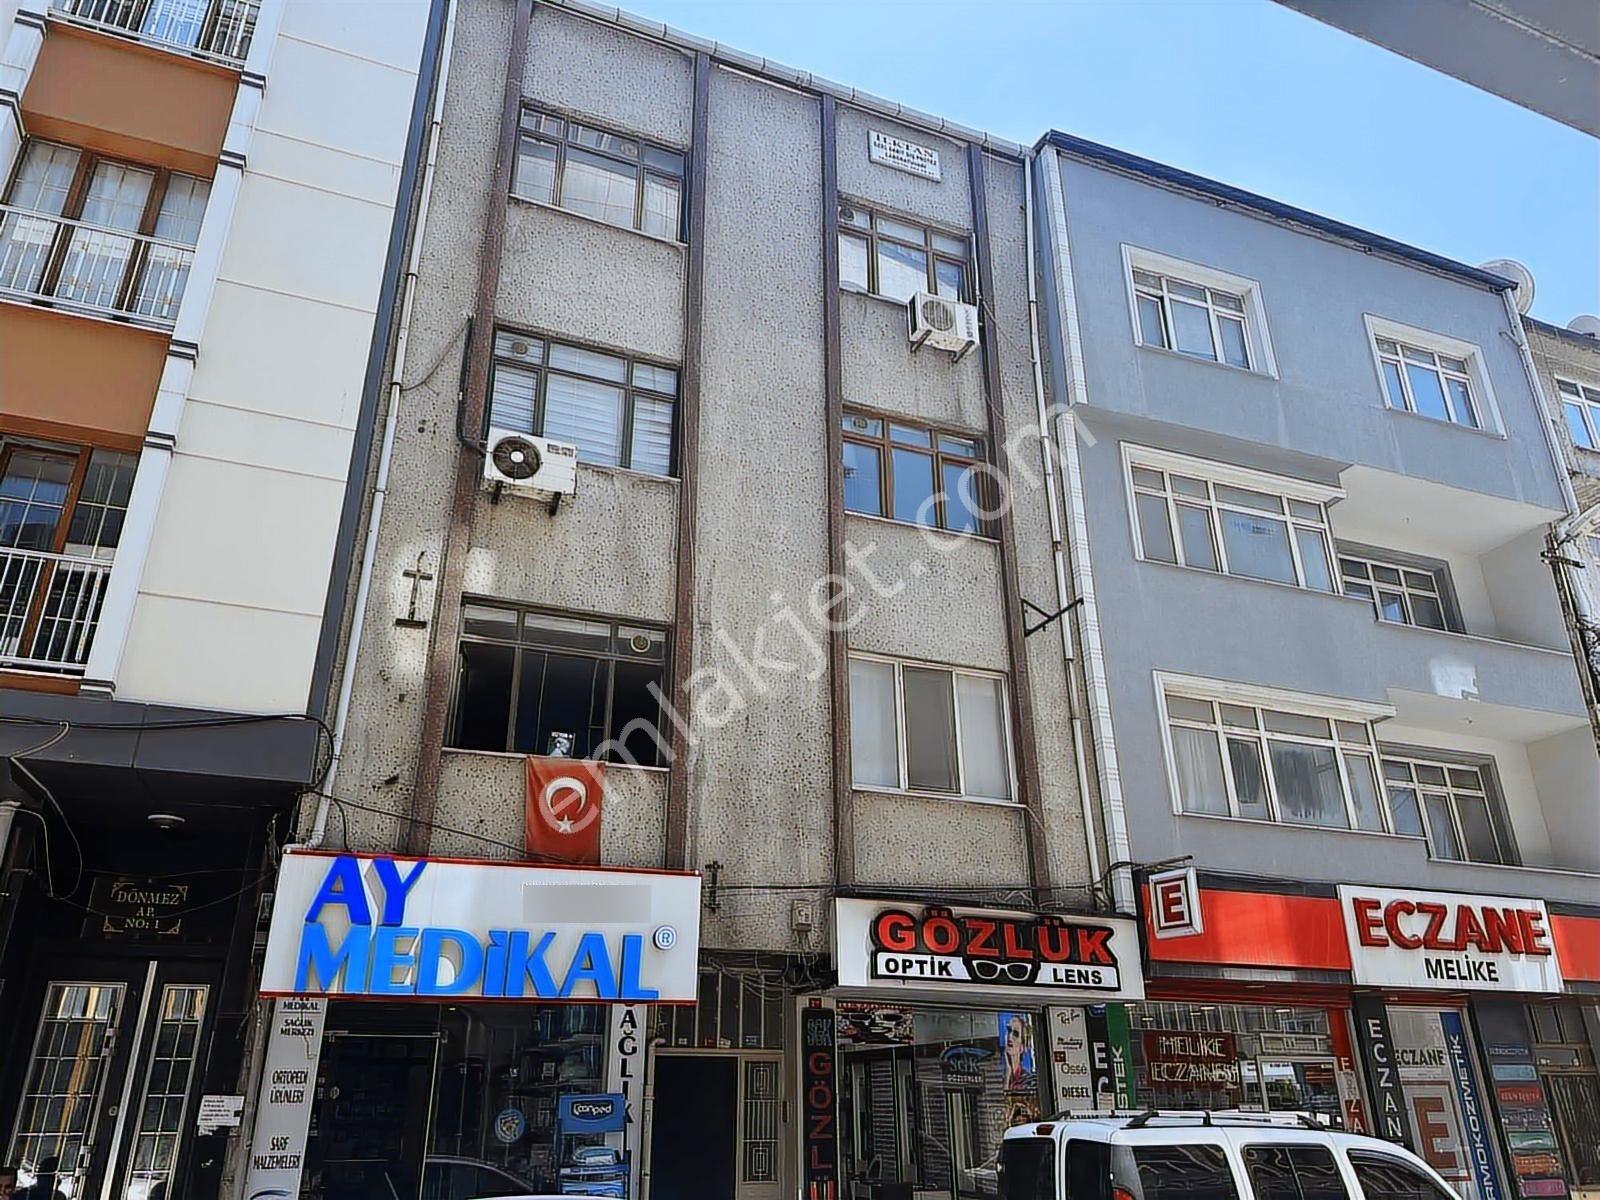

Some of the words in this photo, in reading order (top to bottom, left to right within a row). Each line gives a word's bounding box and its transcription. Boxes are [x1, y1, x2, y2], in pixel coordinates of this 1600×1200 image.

[116, 888, 180, 904] DÖNMEZ
[305, 854, 428, 926] AY
[1160, 882, 1186, 923] E
[878, 909, 1113, 965] GÖZLÜK
[1352, 896, 1552, 956] ECZANE
[293, 922, 660, 1000] MEDİKAL
[884, 956, 952, 977] OPTİK
[1052, 967, 1103, 985] LENS
[1424, 954, 1499, 982] MELİKE
[617, 1001, 638, 1124] AĞLIK
